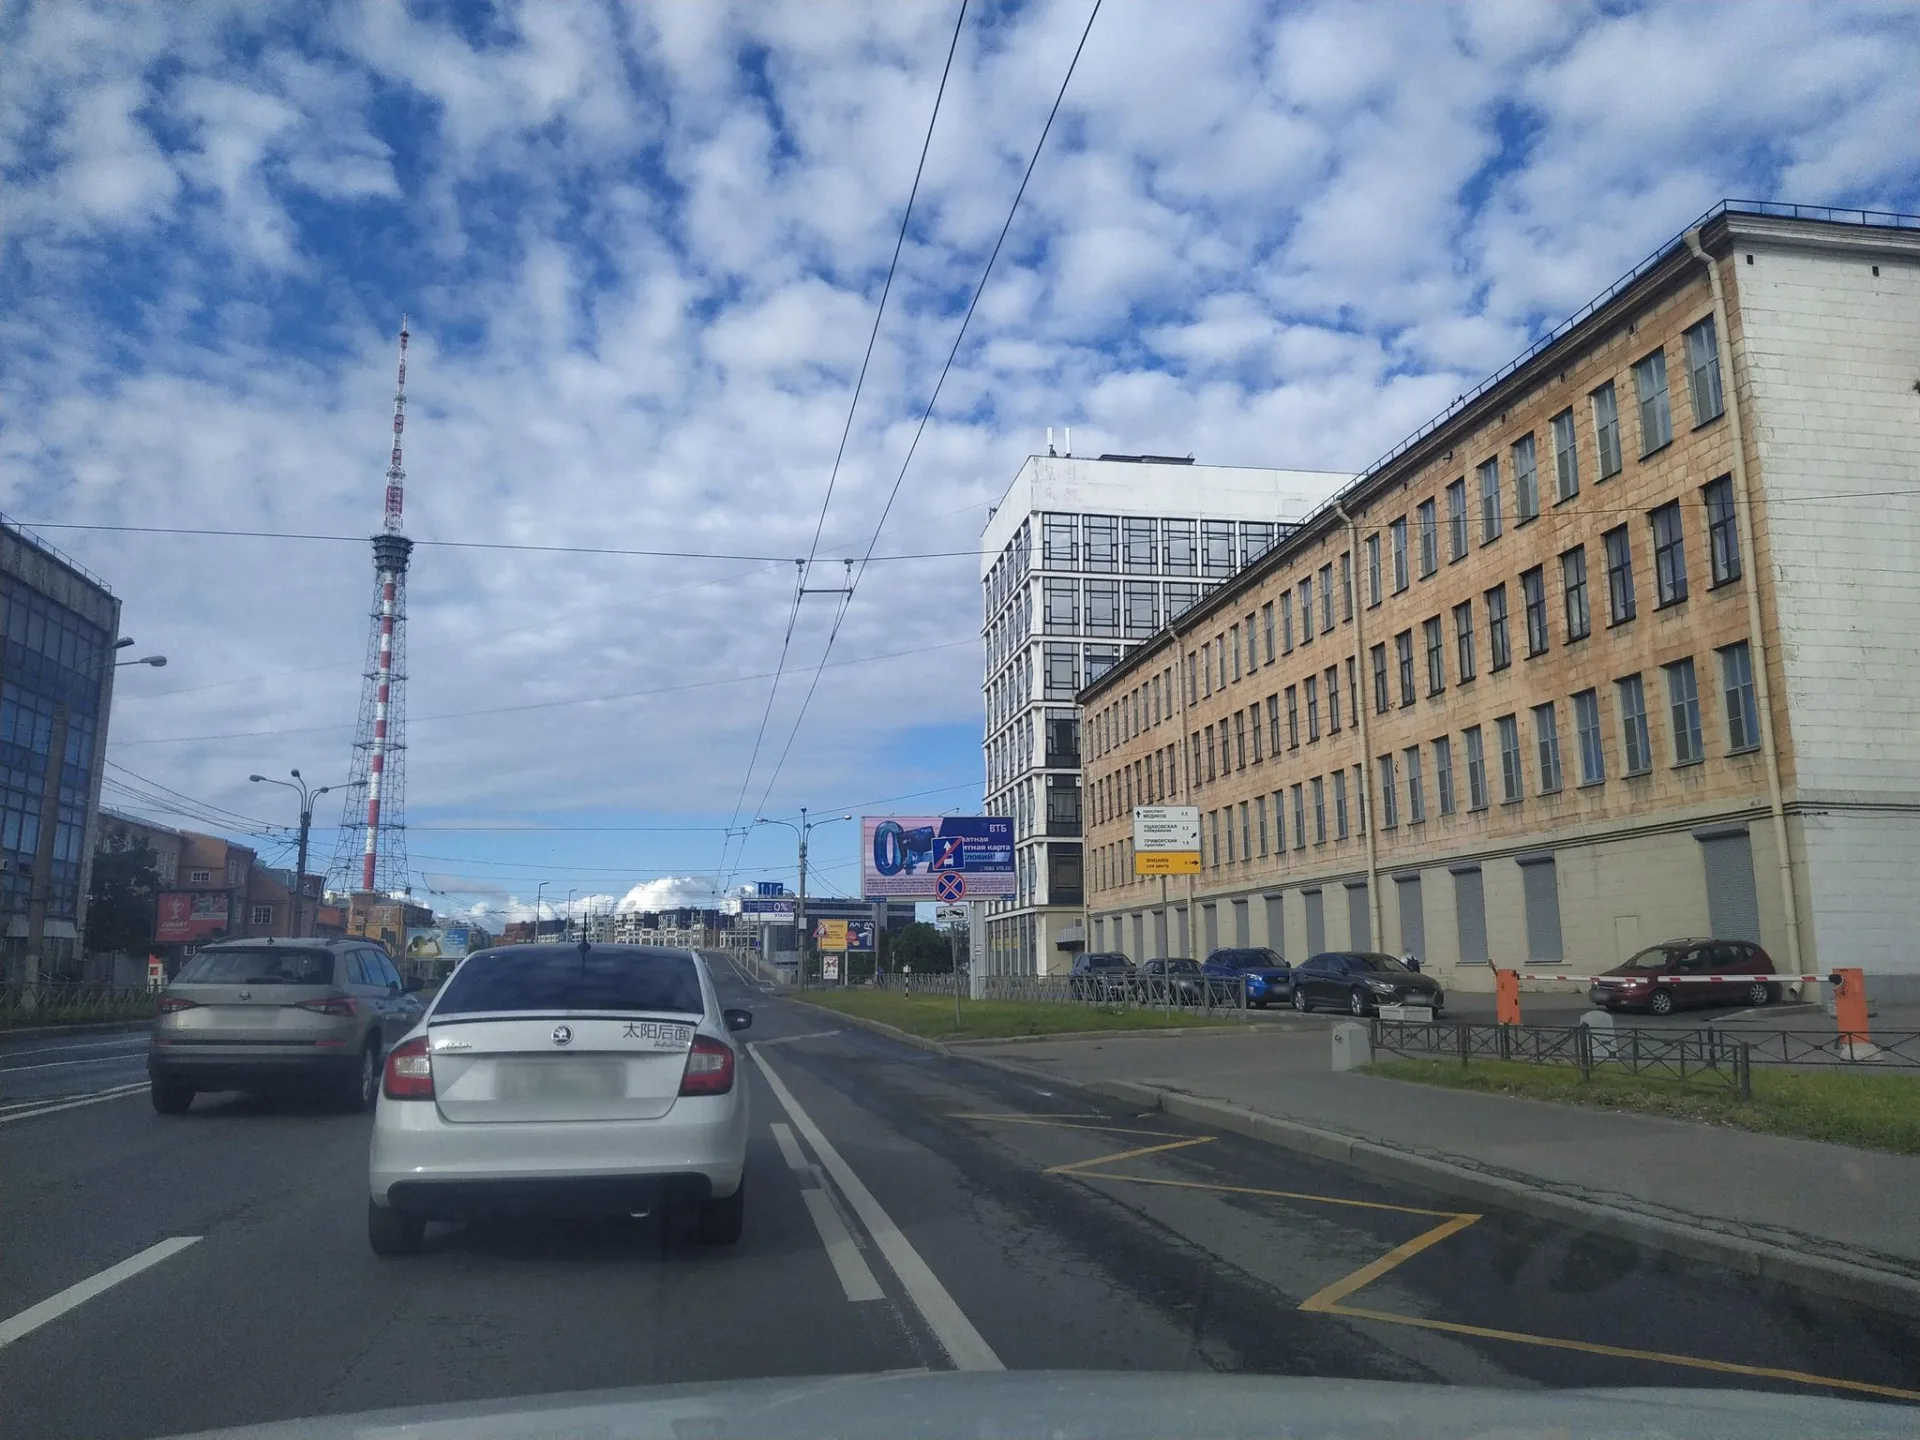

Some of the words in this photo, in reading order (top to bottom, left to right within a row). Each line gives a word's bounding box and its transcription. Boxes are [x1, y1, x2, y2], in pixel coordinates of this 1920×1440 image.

[989, 824, 1007, 833] ВТБ
[987, 844, 1011, 852] карта
[964, 853, 996, 861] словий!
[773, 902, 788, 911] 0%
[623, 1021, 691, 1042] 太阳后面
